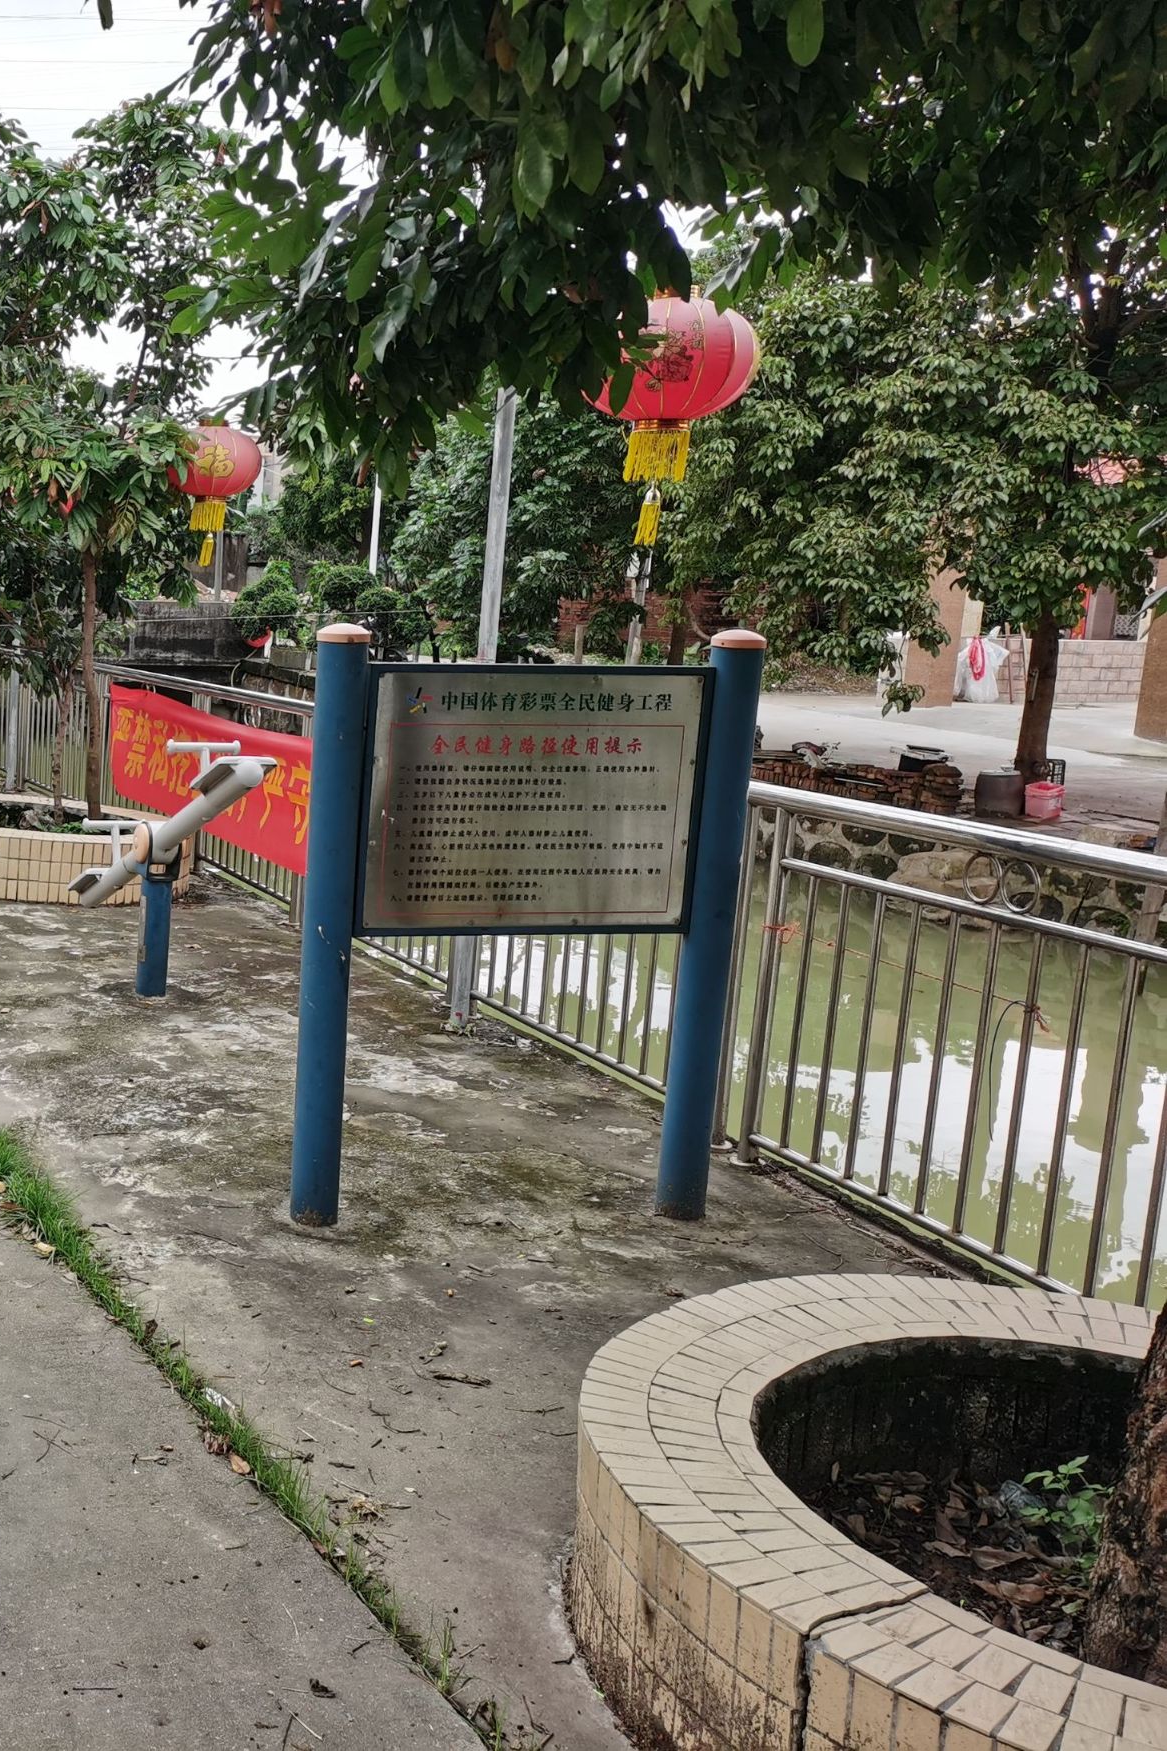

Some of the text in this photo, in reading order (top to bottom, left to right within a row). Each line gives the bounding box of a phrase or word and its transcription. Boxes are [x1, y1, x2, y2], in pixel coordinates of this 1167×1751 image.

[195, 444, 235, 477] 福
[441, 690, 672, 712] 中国体育彩票全民健身工程
[430, 734, 643, 756] 全民健身路径使用提示
